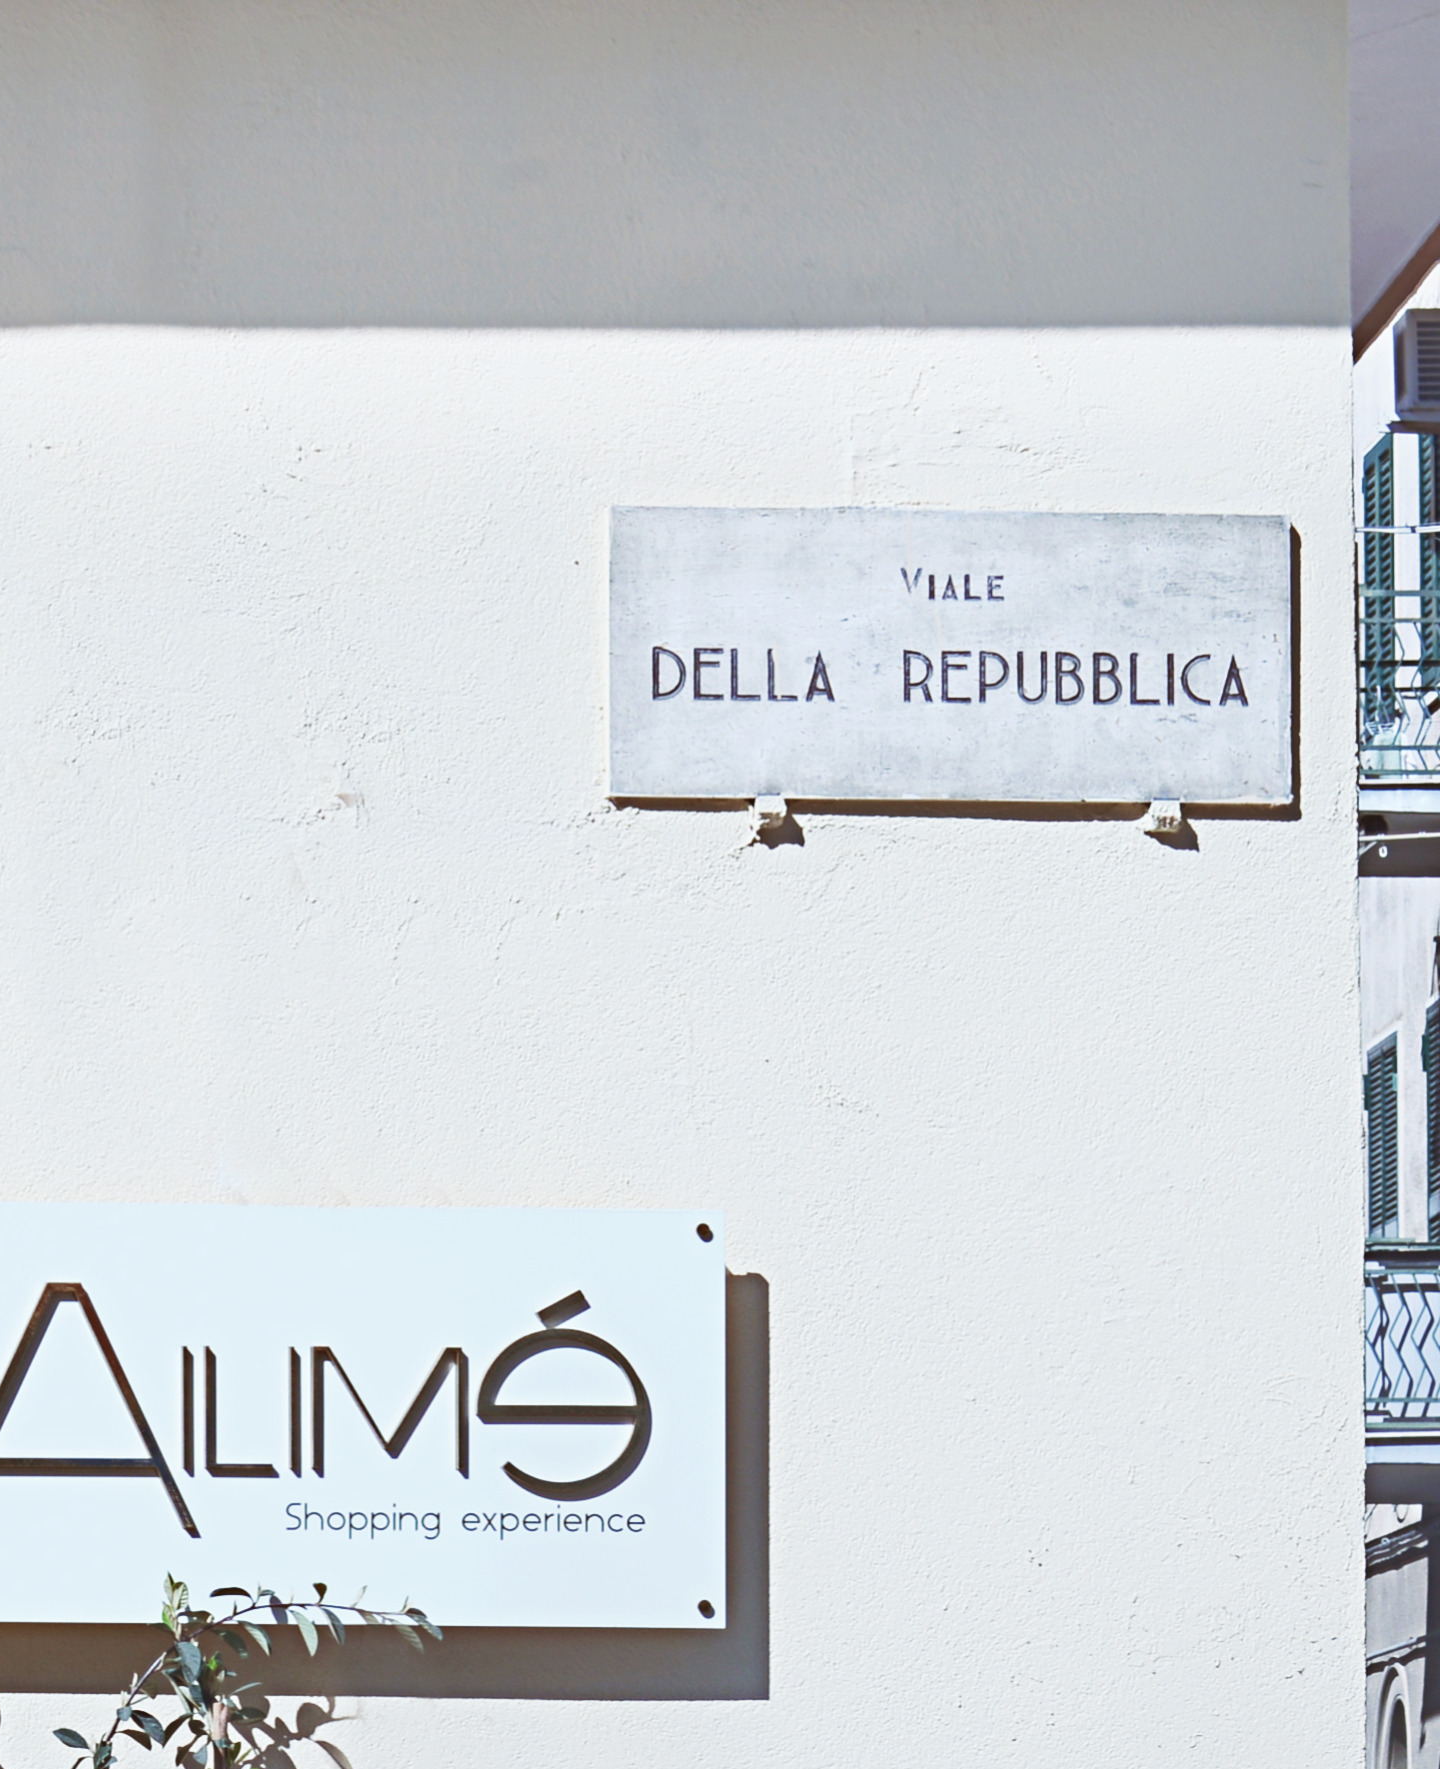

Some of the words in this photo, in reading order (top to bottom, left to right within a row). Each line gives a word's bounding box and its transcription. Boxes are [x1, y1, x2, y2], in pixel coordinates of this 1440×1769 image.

[900, 567, 1005, 601] VIALE
[652, 646, 835, 702] DELLA
[903, 649, 1249, 706] REPUBBLICA
[285, 1502, 441, 1539] Shopping
[461, 1502, 646, 1540] experience
